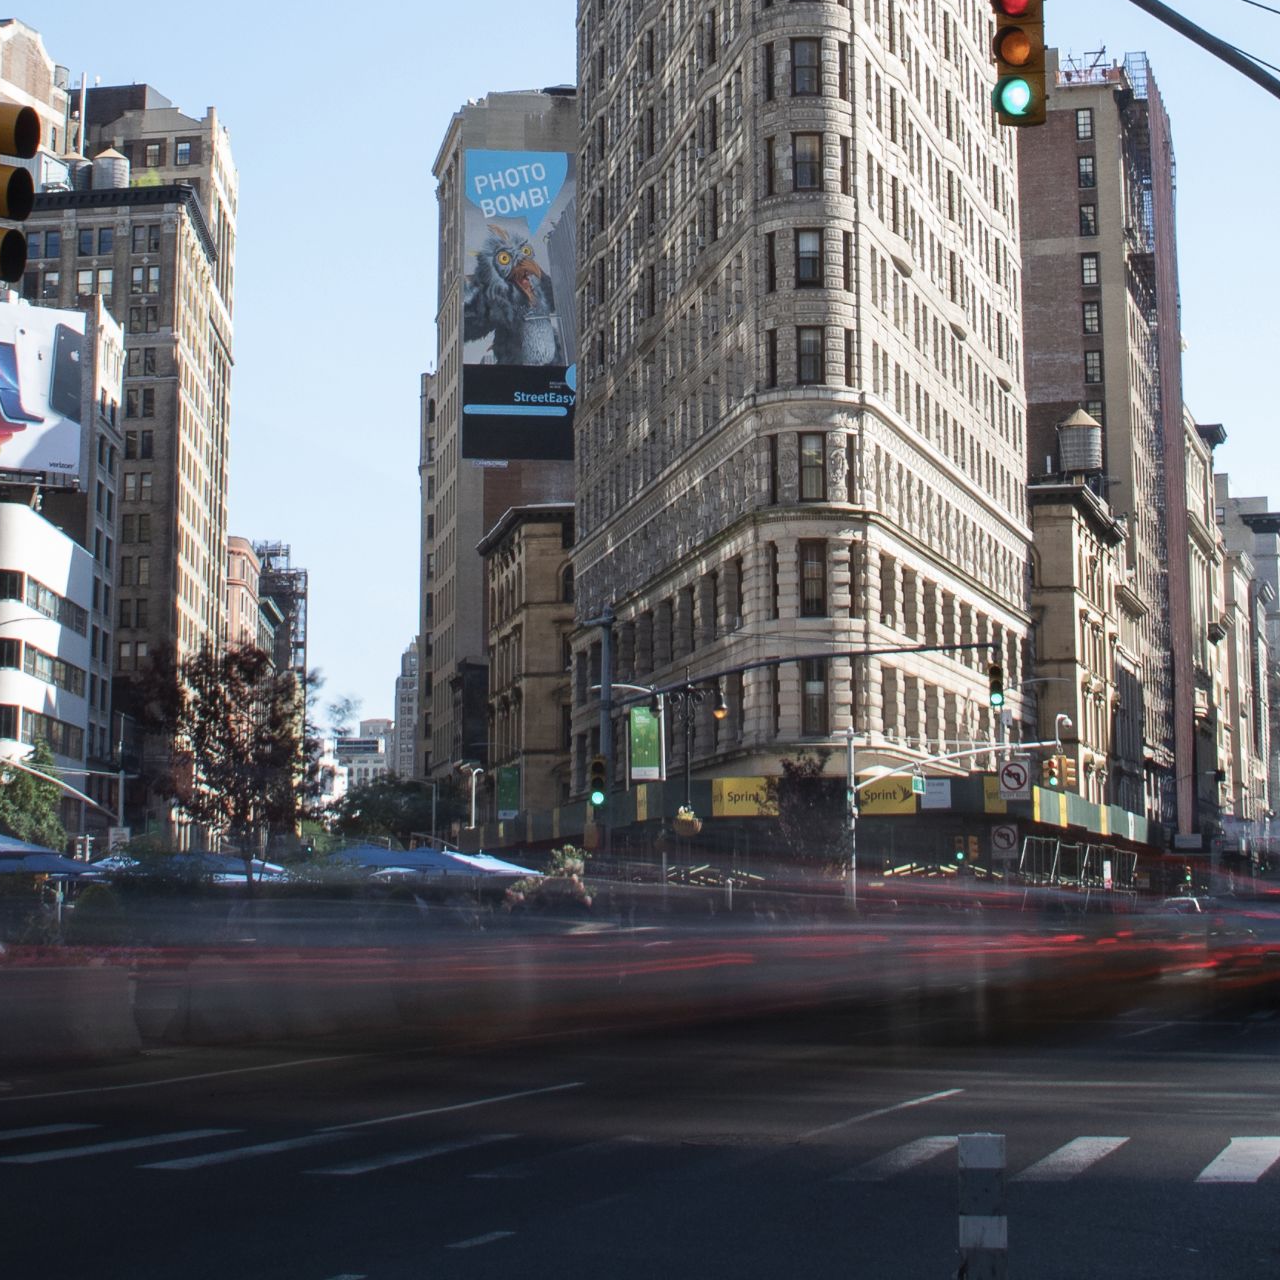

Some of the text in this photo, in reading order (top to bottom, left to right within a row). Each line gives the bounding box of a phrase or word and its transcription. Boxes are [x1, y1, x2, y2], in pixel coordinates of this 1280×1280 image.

[475, 162, 546, 195] PHOTO
[480, 186, 551, 218] BOMB!
[514, 391, 576, 406] StreetEasy
[727, 791, 759, 804] Sprint
[864, 789, 897, 802] Sprint
